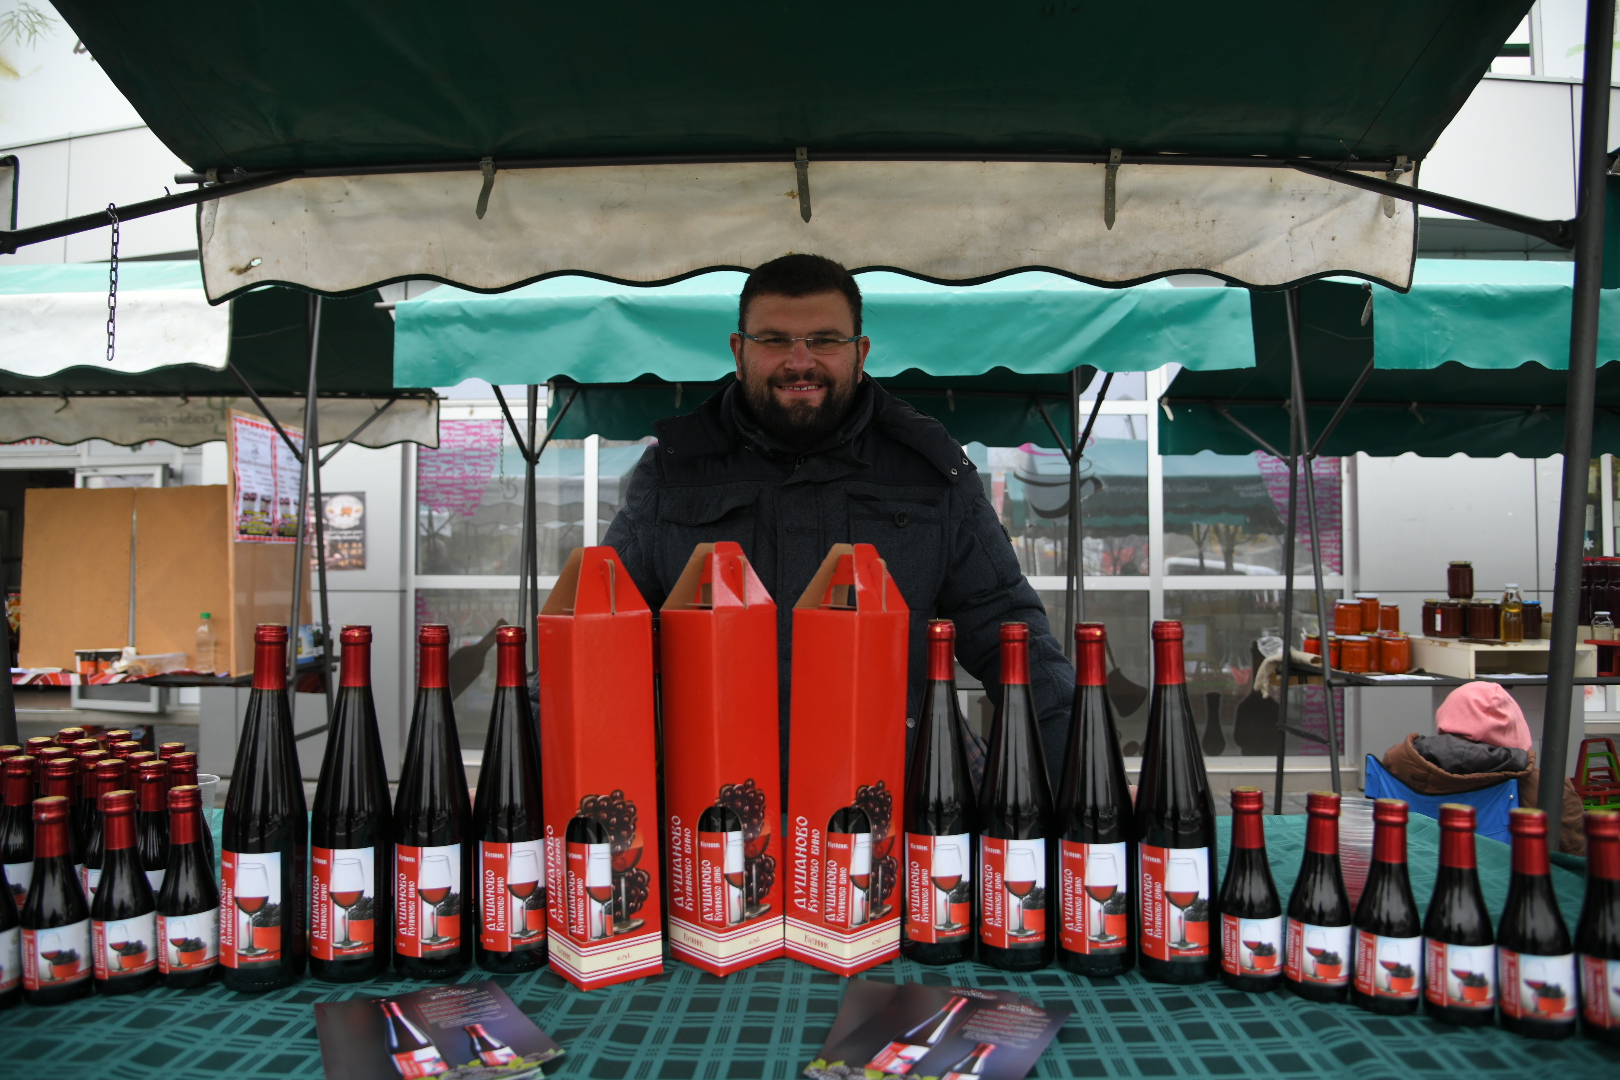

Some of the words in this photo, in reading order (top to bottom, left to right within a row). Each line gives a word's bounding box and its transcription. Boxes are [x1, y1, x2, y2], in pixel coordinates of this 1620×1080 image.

[546, 824, 558, 918] ДУШАНОВО
[671, 816, 684, 906] ДУШАНОВО
[794, 816, 808, 909] ДУШАНОВО
[811, 829, 820, 855] вино
[399, 873, 407, 934] ДУШАНОВО
[486, 870, 495, 930] ДУШАНОВО
[496, 896, 506, 931] Купиново
[684, 858, 694, 911] Купиново
[701, 860, 713, 921] ДУШАНОВО
[808, 859, 820, 912] Купиново
[825, 860, 837, 921] ДУШАНОВО
[911, 861, 920, 921] ДУШАНОВО
[984, 864, 993, 925] ДУШАНОВО
[1063, 869, 1073, 930] ДУШАНОВО
[1143, 873, 1152, 935] ДУШАНОВО
